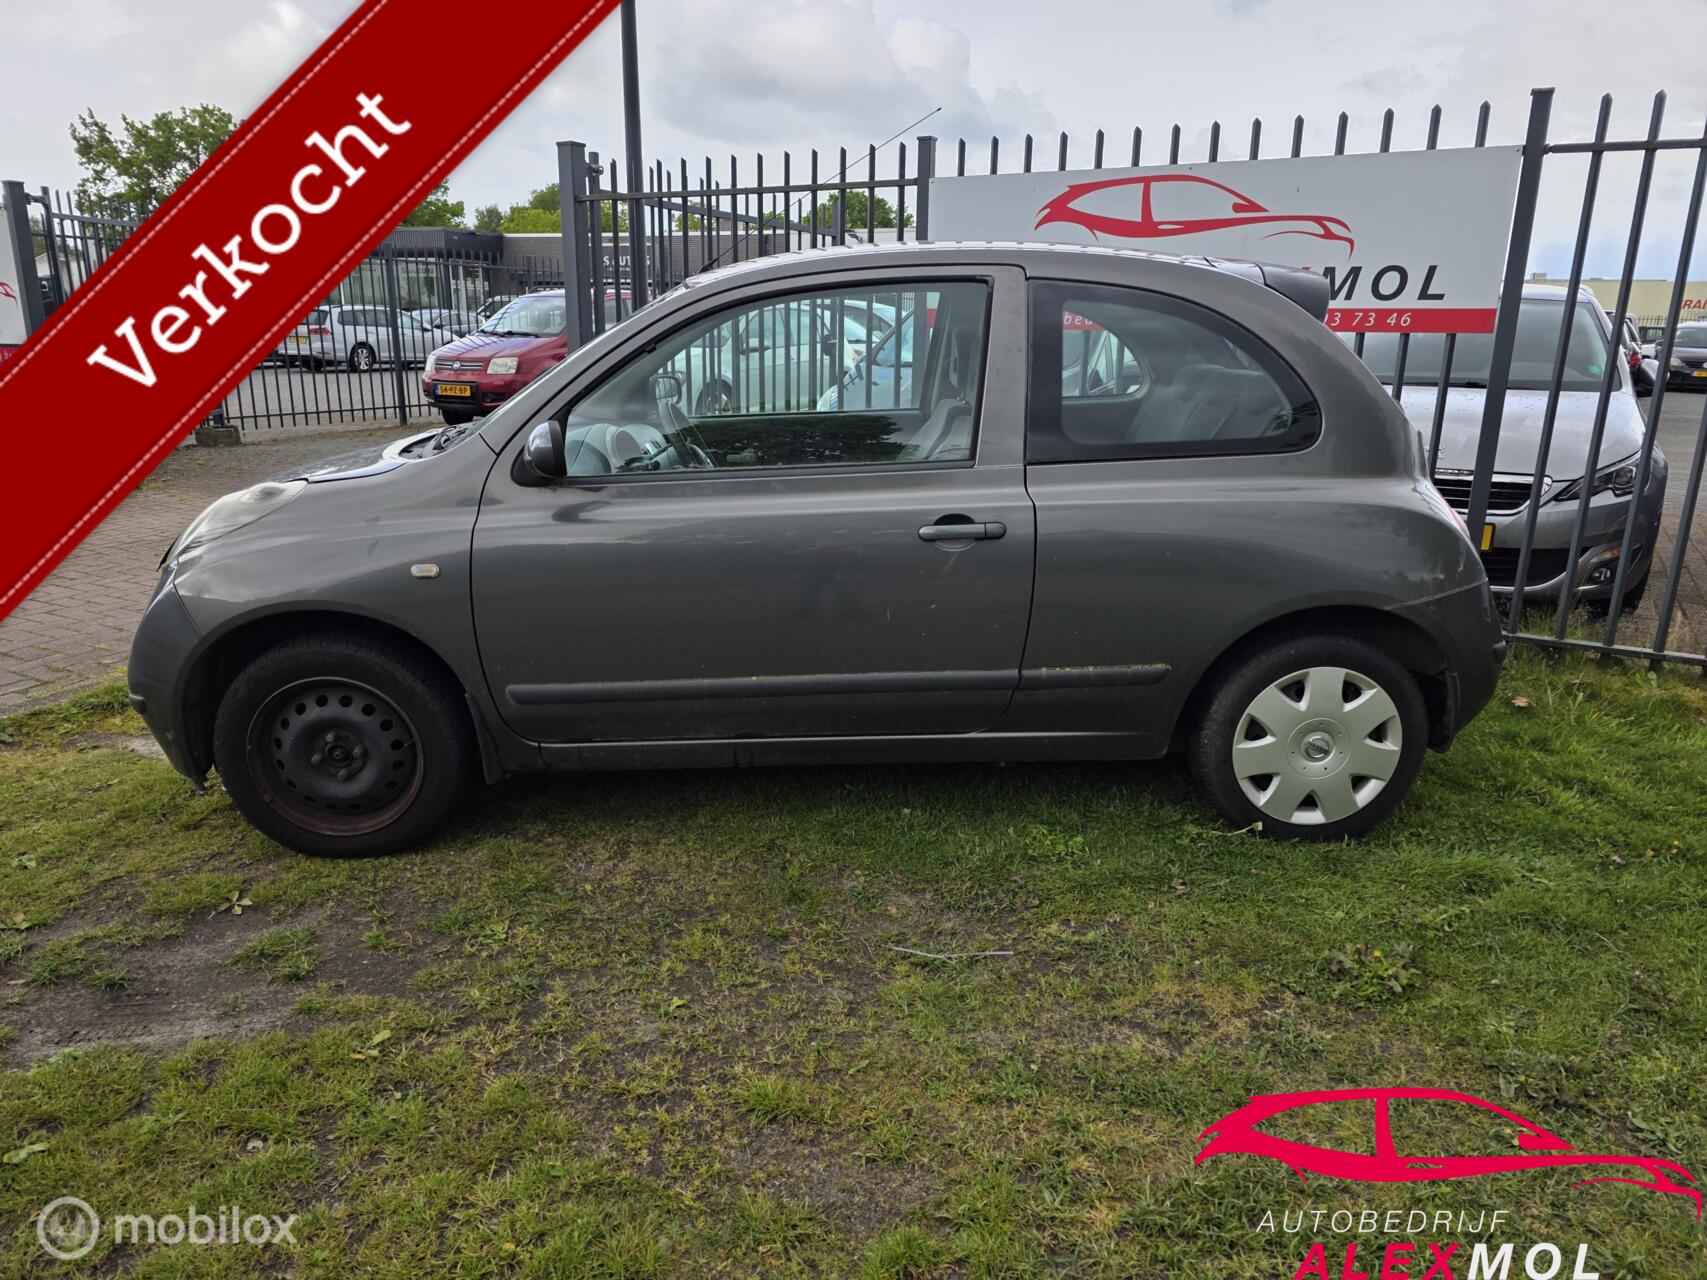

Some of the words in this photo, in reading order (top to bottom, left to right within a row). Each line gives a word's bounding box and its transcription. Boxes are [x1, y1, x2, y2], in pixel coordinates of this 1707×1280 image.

[1302, 264, 1446, 301] MOL
[1352, 312, 1376, 326] 73
[1386, 312, 1412, 326] 46
